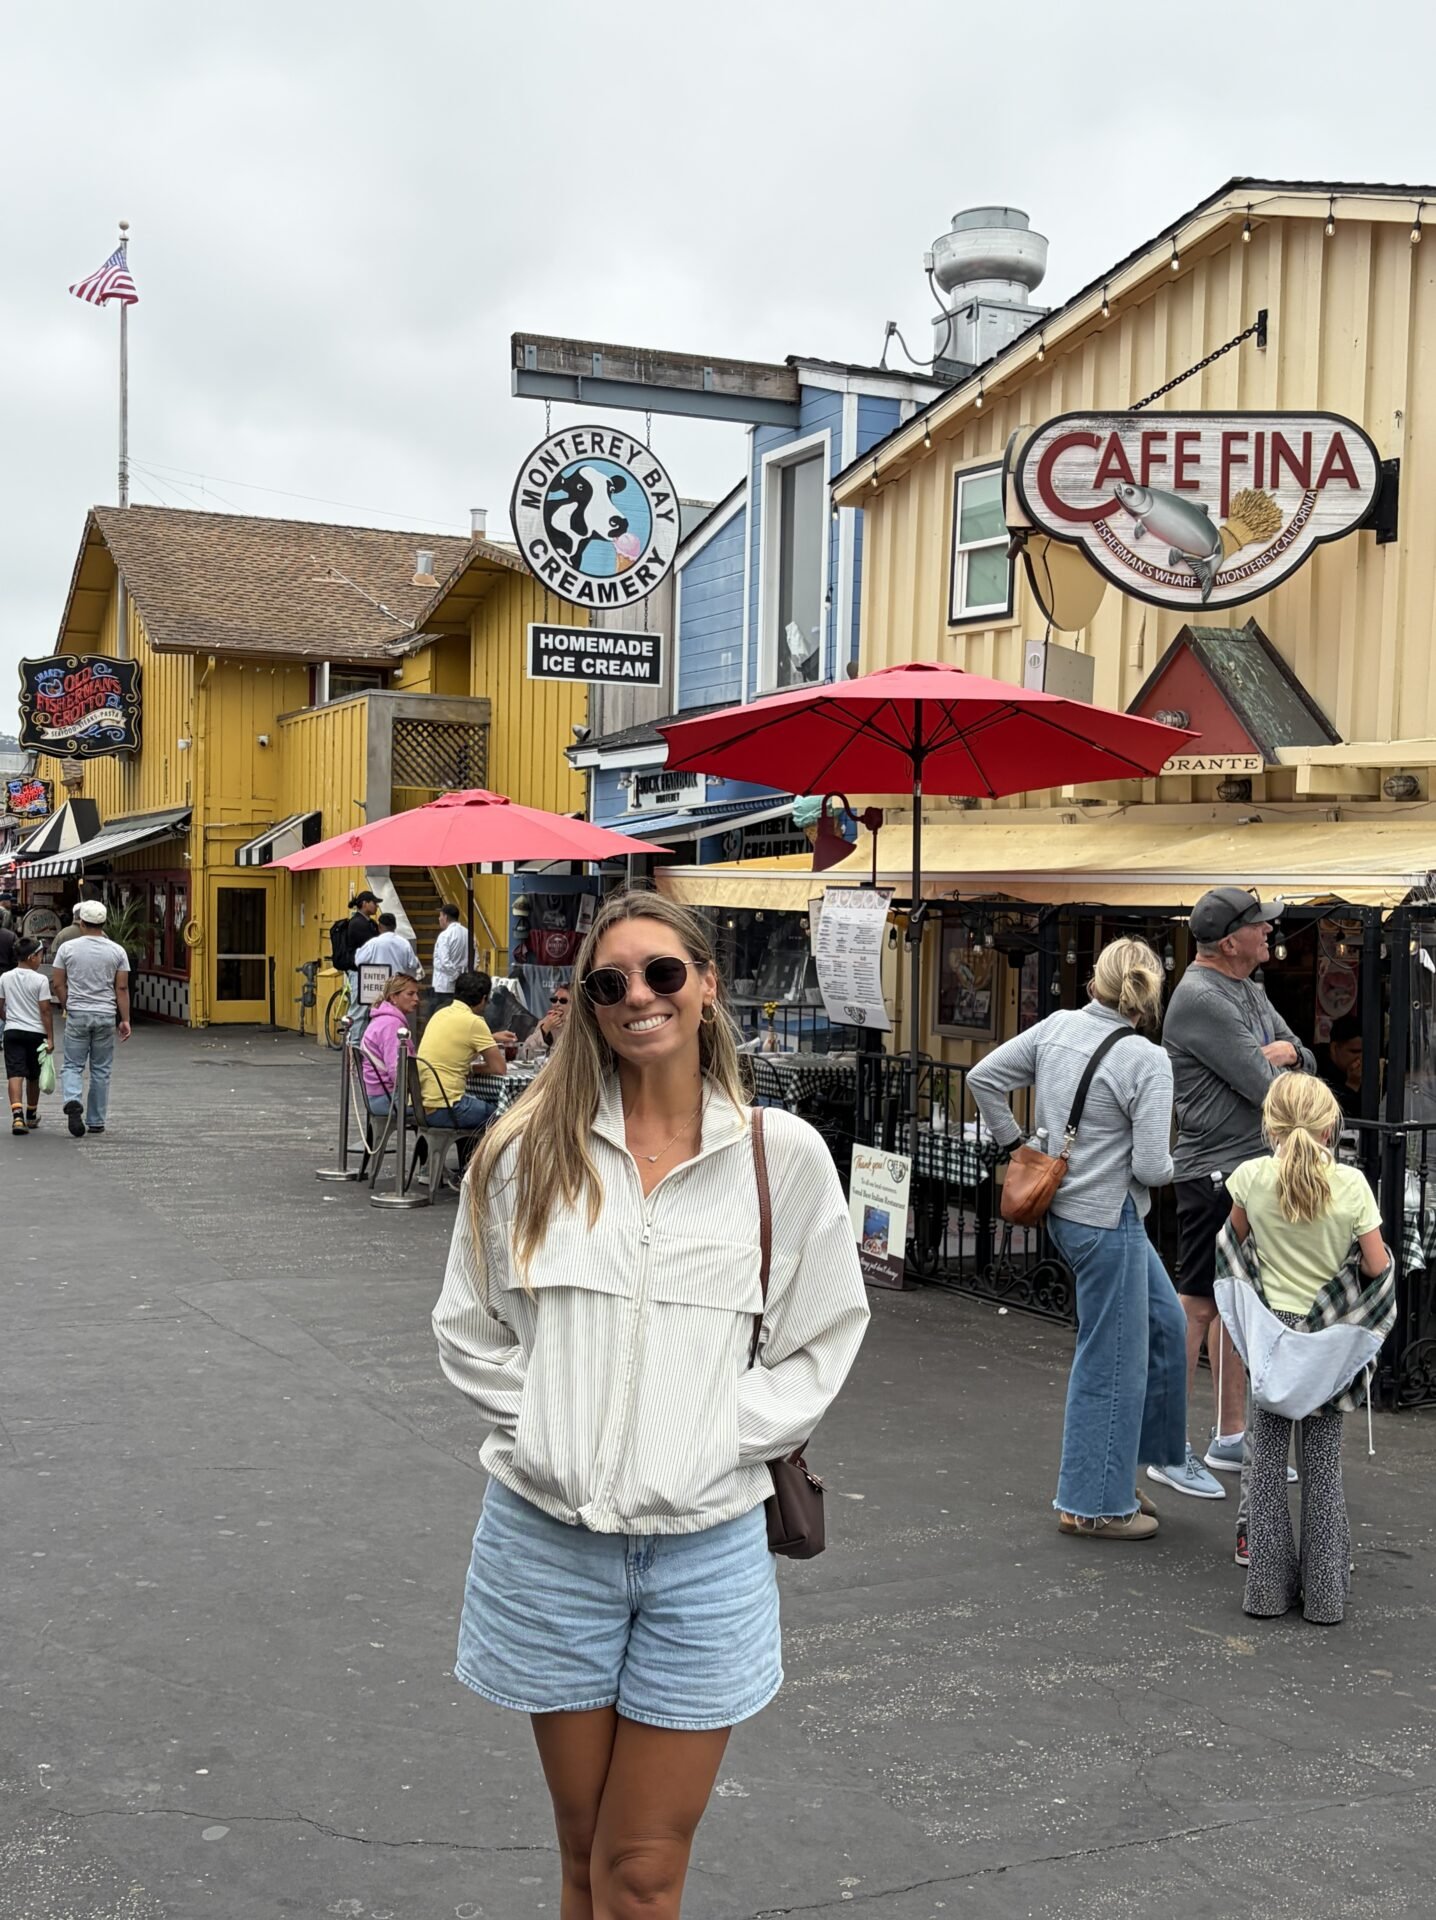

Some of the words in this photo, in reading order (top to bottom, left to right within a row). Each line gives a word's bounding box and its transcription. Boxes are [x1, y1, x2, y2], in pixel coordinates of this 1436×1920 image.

[520, 431, 643, 510] MONTEREY
[642, 467, 675, 524] BAY
[1037, 431, 1201, 522] CAFE
[1220, 431, 1362, 518] FINA
[1215, 549, 1278, 585] MONTEREY
[1275, 490, 1318, 553] CALIFORNIA
[1094, 519, 1154, 577] FISHERMAN'S
[1152, 569, 1198, 587] WHARF
[528, 538, 667, 603] CREAMERY
[539, 632, 654, 657] HOMEMADE
[63, 666, 93, 692] OLD
[541, 654, 577, 673] ICE
[581, 657, 651, 678] CREAM
[51, 692, 106, 728] GROTTO
[100, 709, 120, 718] PASTA
[1161, 758, 1258, 771] ORANTE
[363, 972, 386, 980] ENTER
[363, 983, 385, 991] HERE
